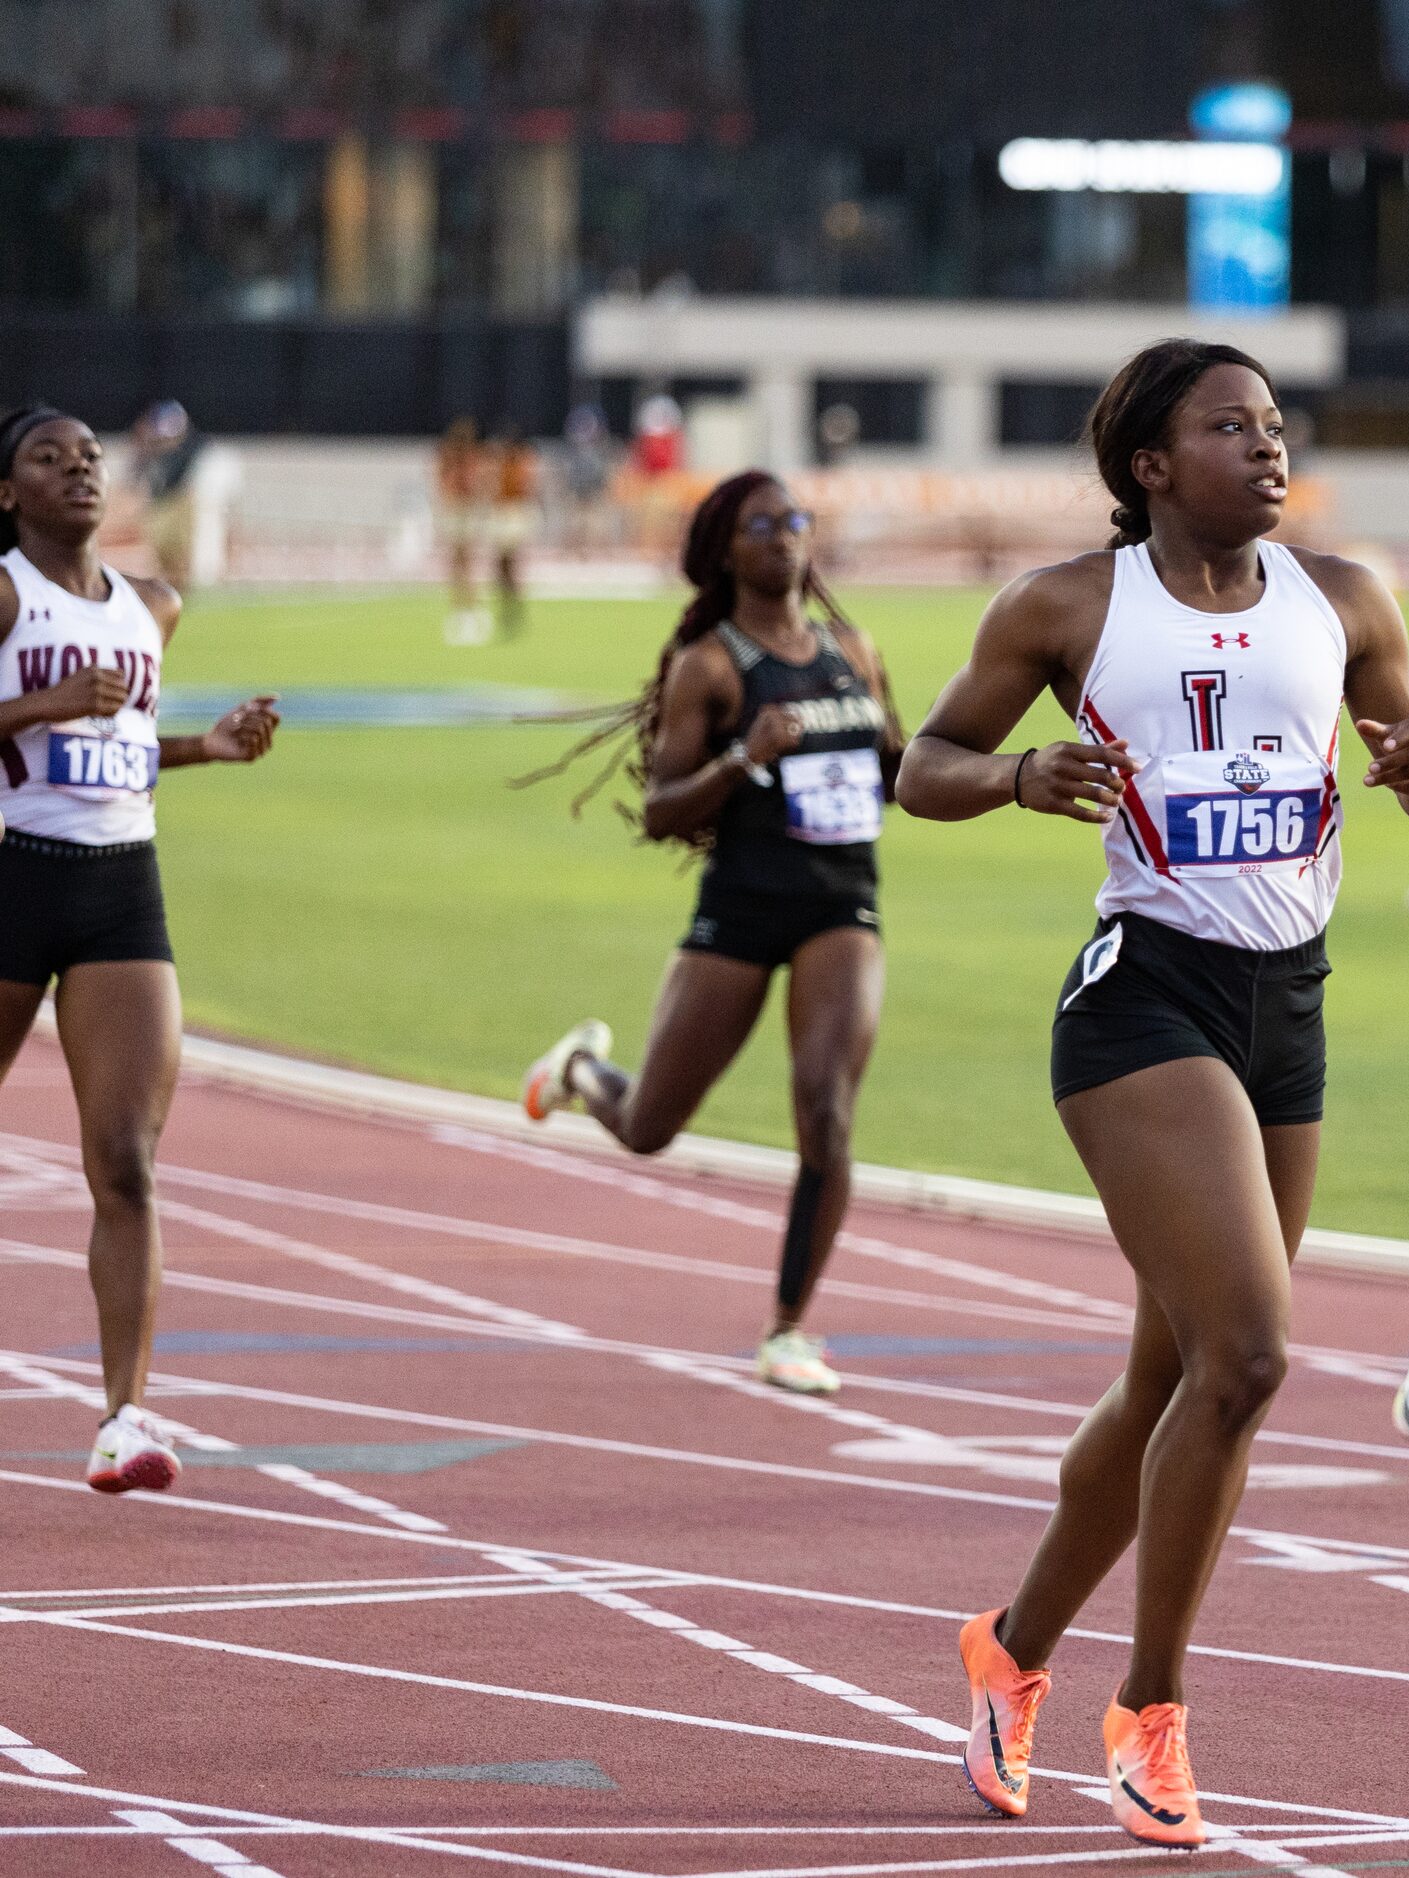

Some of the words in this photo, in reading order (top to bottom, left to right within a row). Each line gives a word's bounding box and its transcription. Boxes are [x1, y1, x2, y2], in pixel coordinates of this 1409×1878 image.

[64, 737, 149, 792] 1763
[1224, 769, 1269, 780] STATE
[1187, 796, 1305, 857] 1756
[1238, 865, 1262, 874] 2022
